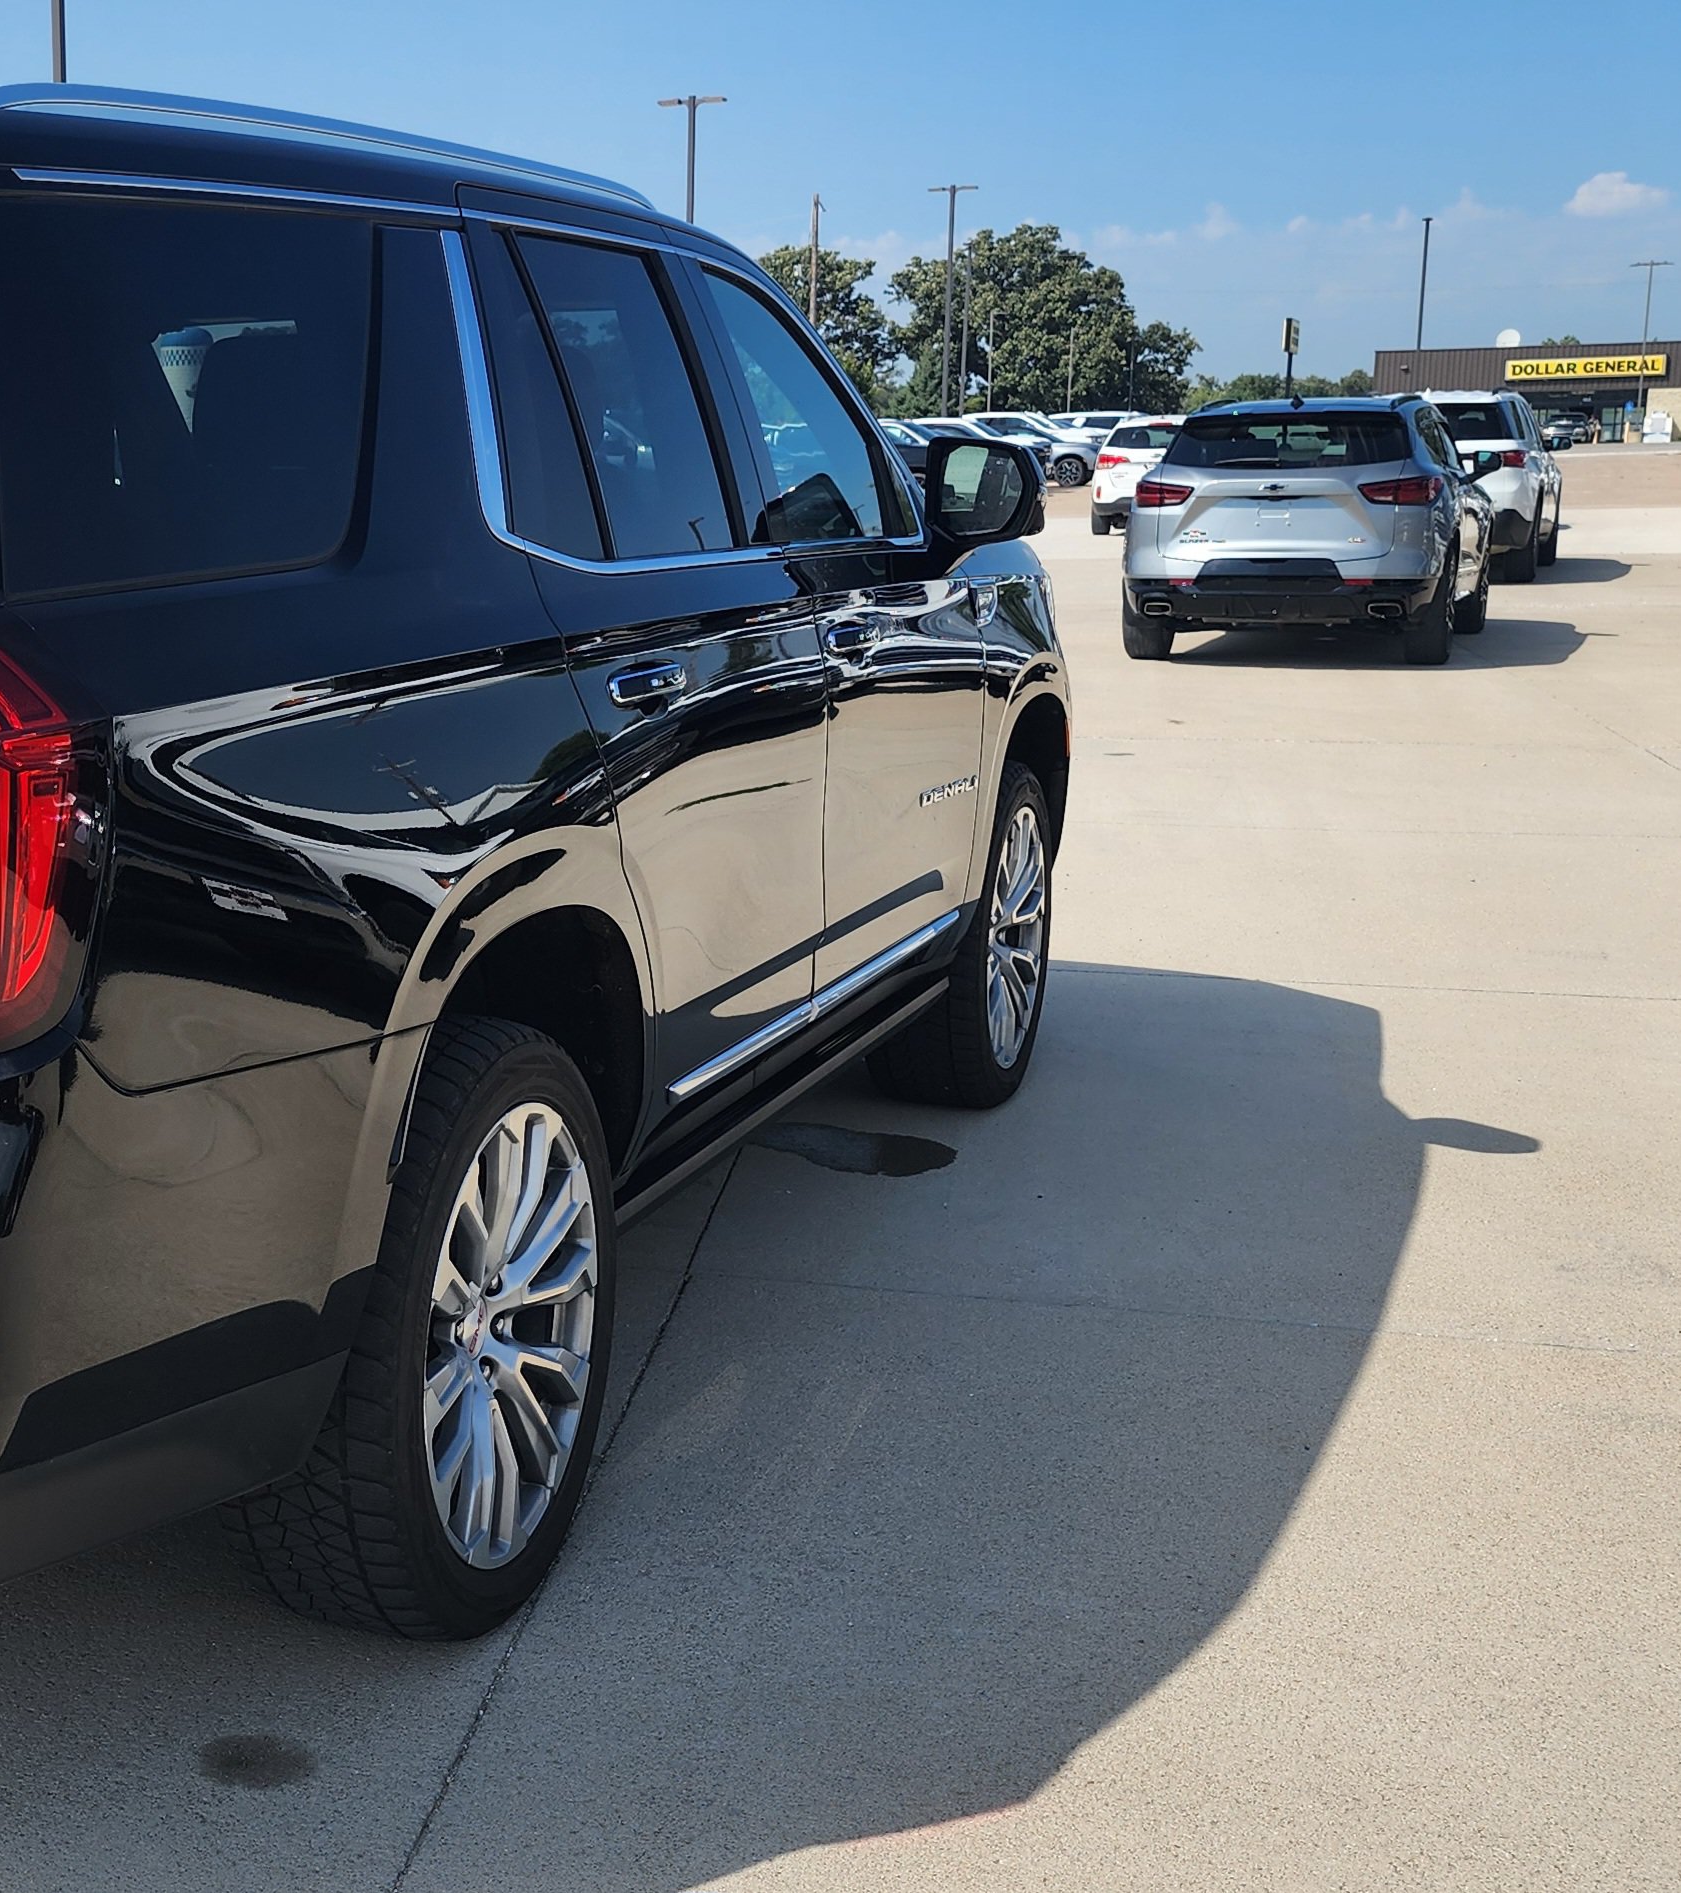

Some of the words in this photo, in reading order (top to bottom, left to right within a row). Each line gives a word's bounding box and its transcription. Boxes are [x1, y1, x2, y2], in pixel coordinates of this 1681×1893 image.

[1512, 362, 1577, 376] DOLLAR
[1583, 358, 1660, 373] GENERAL
[919, 775, 979, 808] DENALI
